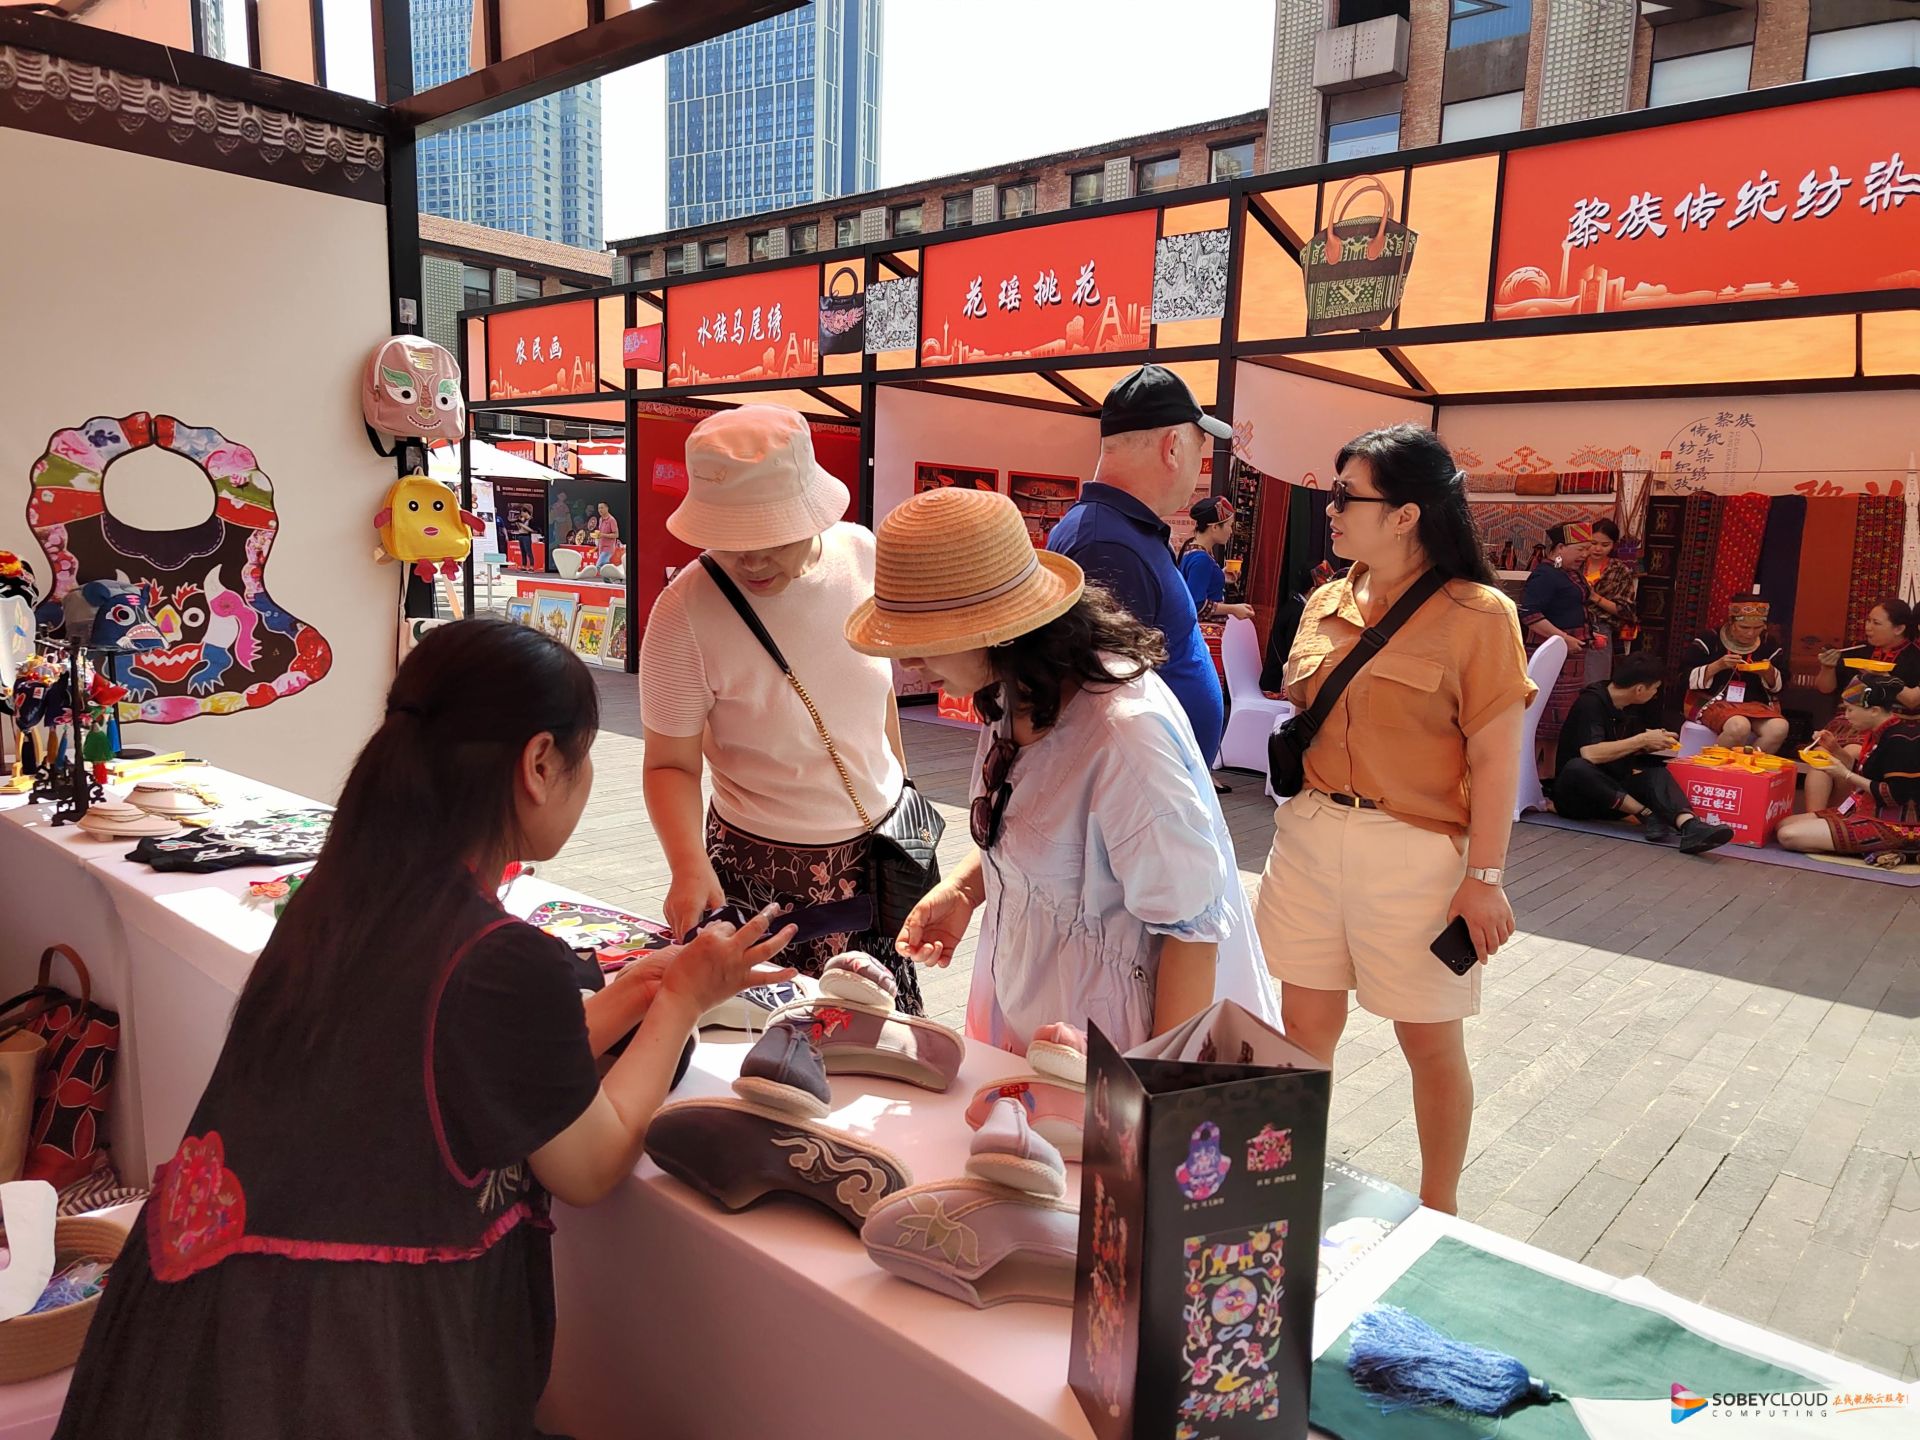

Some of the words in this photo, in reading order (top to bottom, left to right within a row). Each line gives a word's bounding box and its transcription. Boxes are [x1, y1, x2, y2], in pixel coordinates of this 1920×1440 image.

[1566, 152, 1920, 248] 黎族传统纺染
[963, 259, 1101, 319] 花瑶挑花
[697, 302, 783, 347] 水族马尾绣
[515, 335, 563, 366] 农民画
[1715, 411, 1755, 428] 黎族
[1691, 795, 1736, 811] 干净卫生
[1692, 784, 1738, 800] 好吃放心
